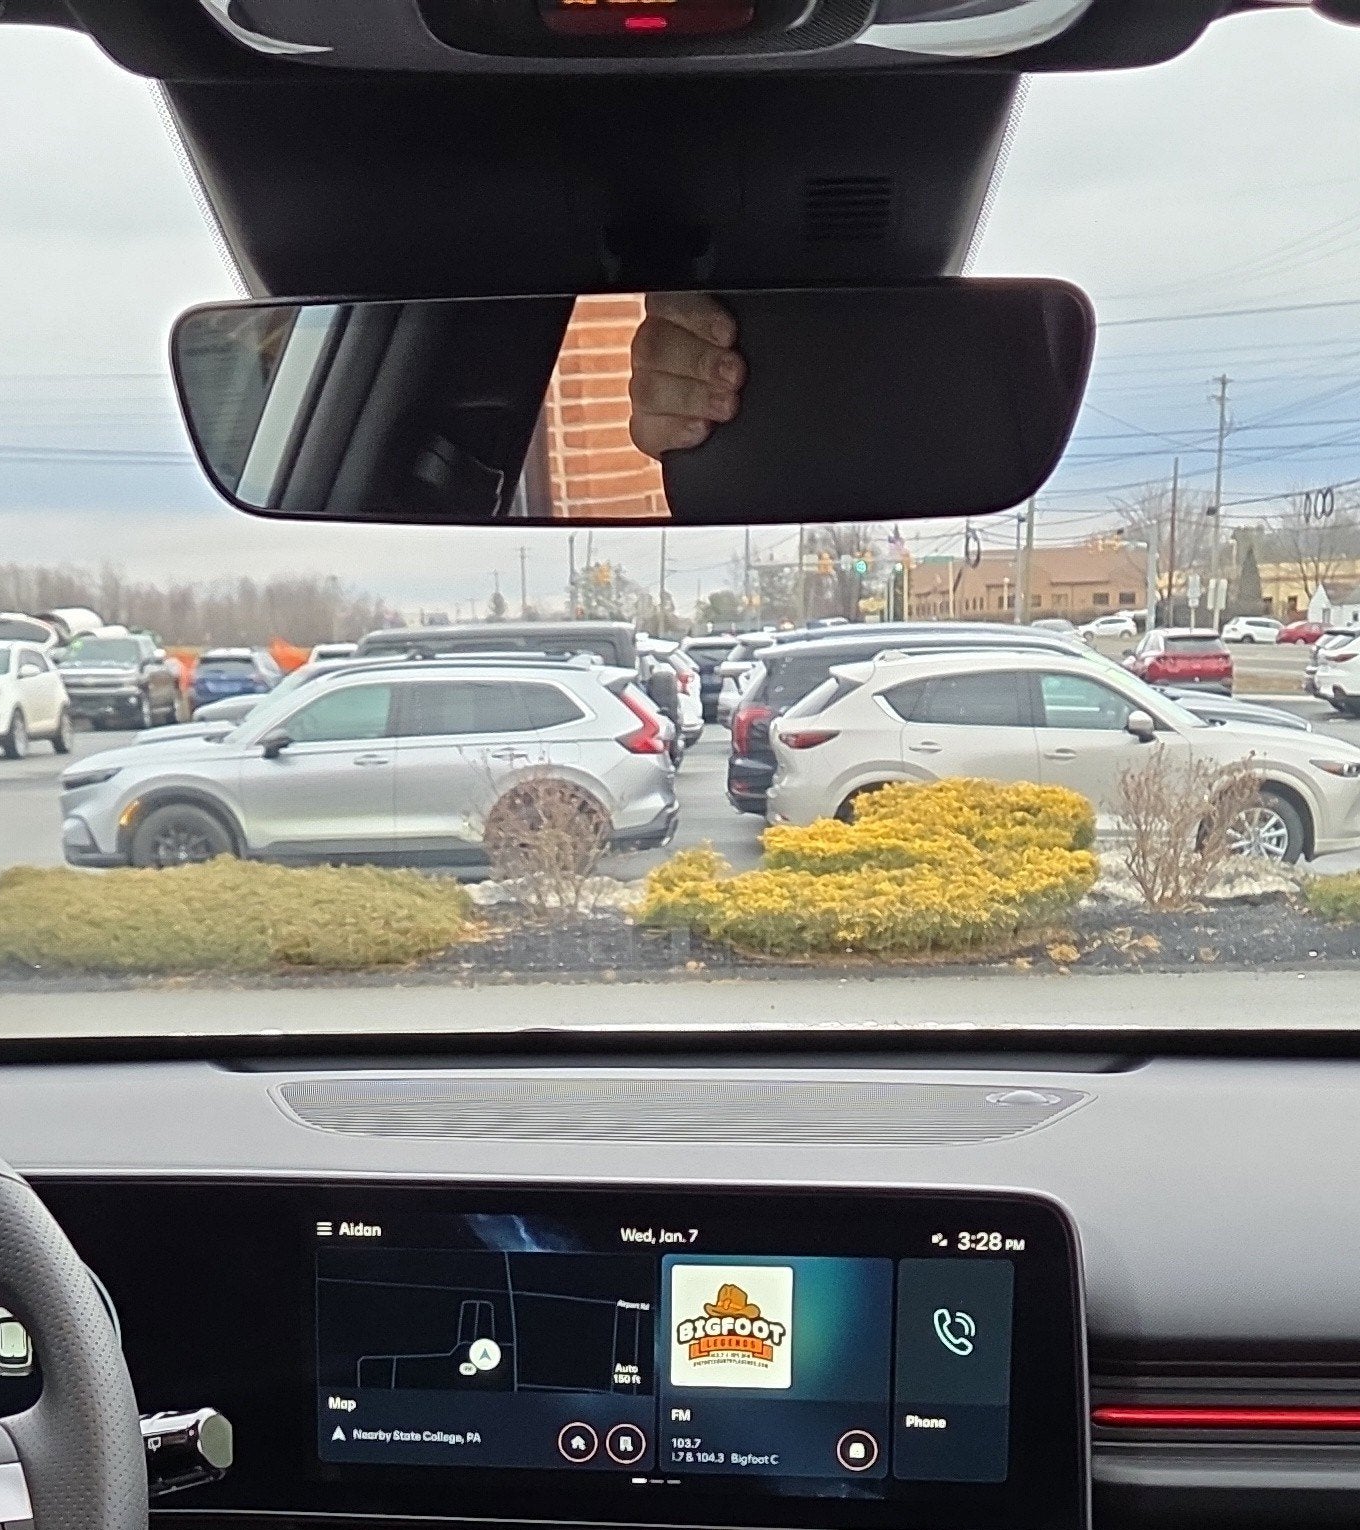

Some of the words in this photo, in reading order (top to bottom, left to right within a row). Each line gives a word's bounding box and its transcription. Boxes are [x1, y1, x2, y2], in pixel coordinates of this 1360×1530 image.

[339, 1221, 382, 1238] Aidan
[620, 1227, 657, 1245] Wed,
[659, 1228, 687, 1244] Jan.
[688, 1228, 699, 1243] 7
[957, 1231, 1003, 1251] 3:28
[1004, 1238, 1026, 1251] PM
[678, 1316, 786, 1346] BIGFOOT
[706, 1338, 756, 1349] LEGENDS
[615, 1362, 639, 1374] Auto
[328, 1396, 357, 1412] Map
[671, 1408, 691, 1422] FM
[905, 1414, 947, 1430] Phone
[352, 1428, 392, 1444] Nearby
[393, 1429, 422, 1442] State
[422, 1430, 465, 1445] College,
[466, 1431, 482, 1444] PA
[671, 1437, 702, 1449] 103.7
[696, 1452, 725, 1464] 104.3
[730, 1452, 770, 1467] Bigfoot
[770, 1454, 780, 1465] C
